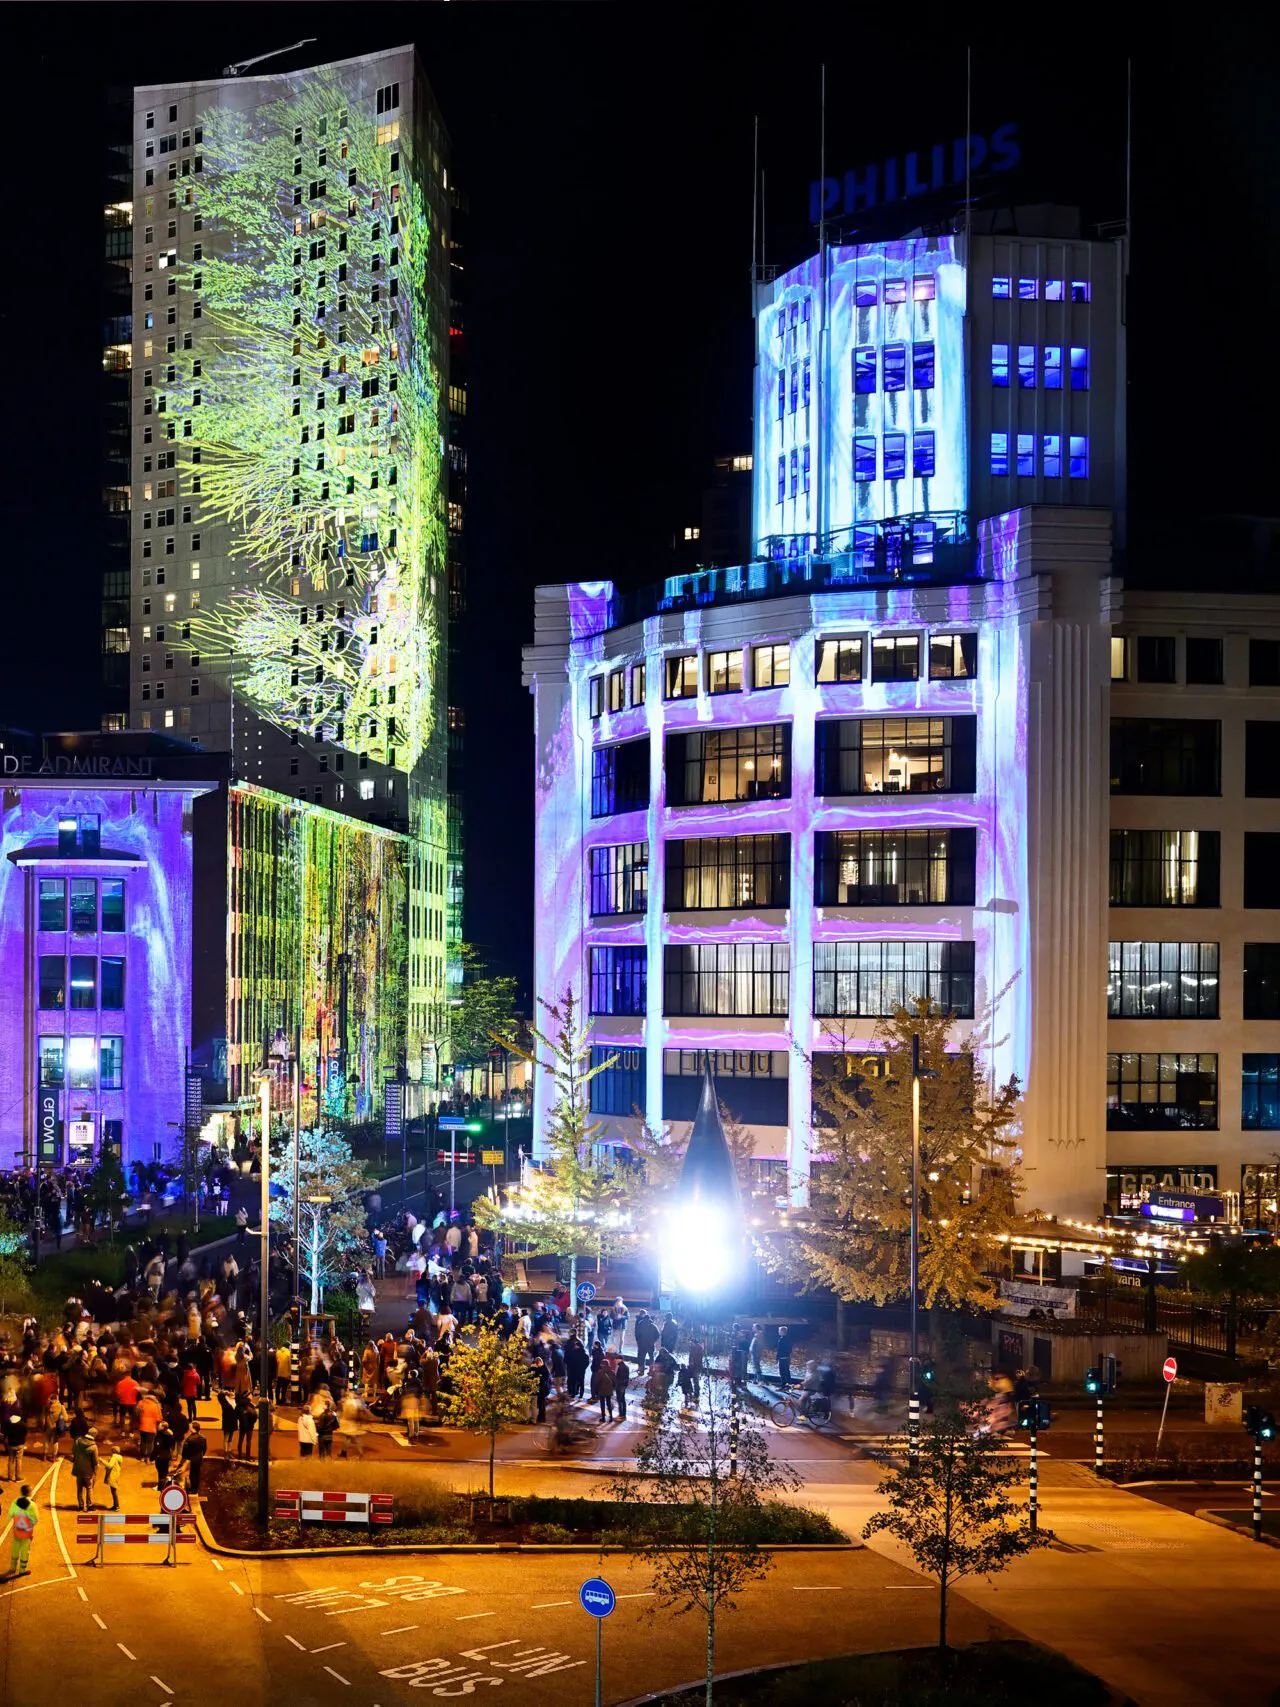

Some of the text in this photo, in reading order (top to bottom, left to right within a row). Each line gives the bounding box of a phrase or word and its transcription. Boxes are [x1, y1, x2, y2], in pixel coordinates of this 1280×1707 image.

[809, 122, 1020, 225] PHILIPS
[4, 755, 153, 775] DE ADMIRANT
[1121, 1173, 1214, 1195] GRAND
[1158, 1196, 1196, 1209] Entrance
[1117, 1272, 1142, 1288] varia
[273, 1586, 390, 1615] LIJN
[359, 1575, 468, 1601] BUS
[459, 1639, 587, 1678] LIJN
[377, 1658, 504, 1697] BUS
